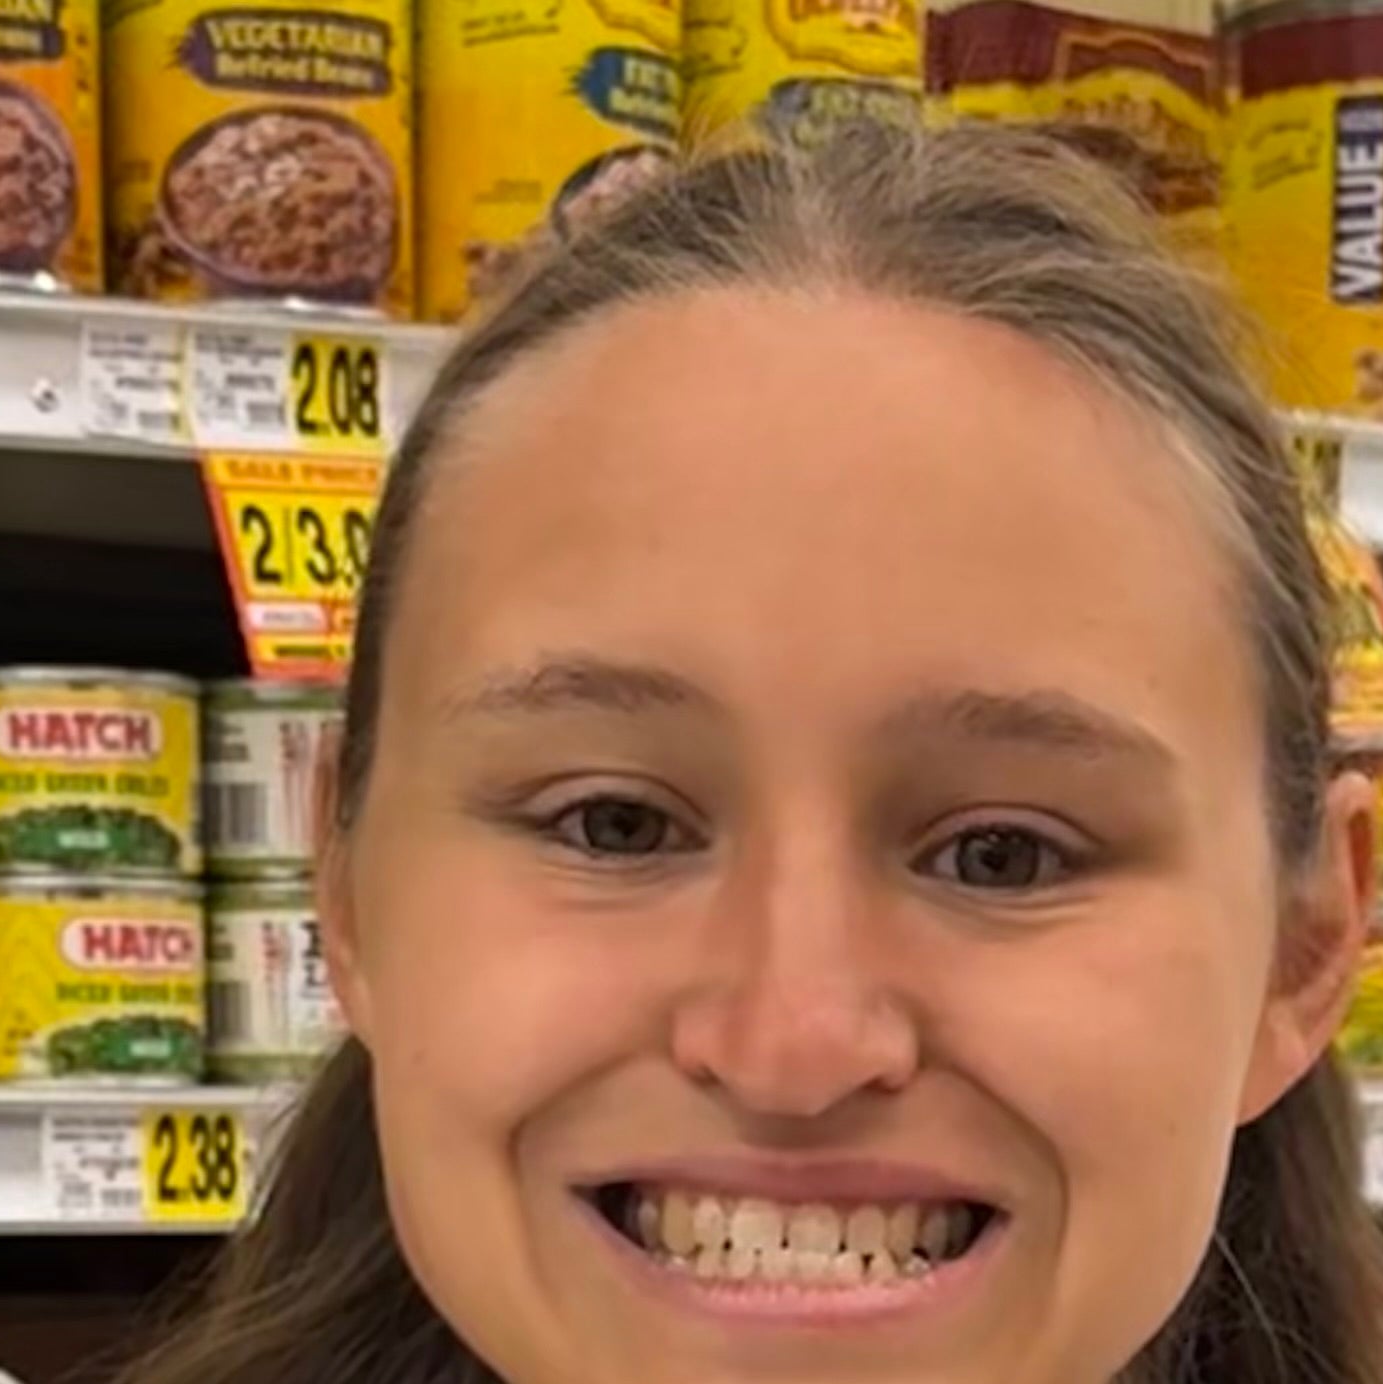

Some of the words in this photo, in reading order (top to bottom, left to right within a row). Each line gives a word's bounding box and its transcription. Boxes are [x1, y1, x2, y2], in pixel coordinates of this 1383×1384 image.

[292, 344, 381, 438] 2.08
[7, 711, 153, 754] HATCH
[82, 924, 194, 963] HATC
[153, 1112, 242, 1202] 2.38
